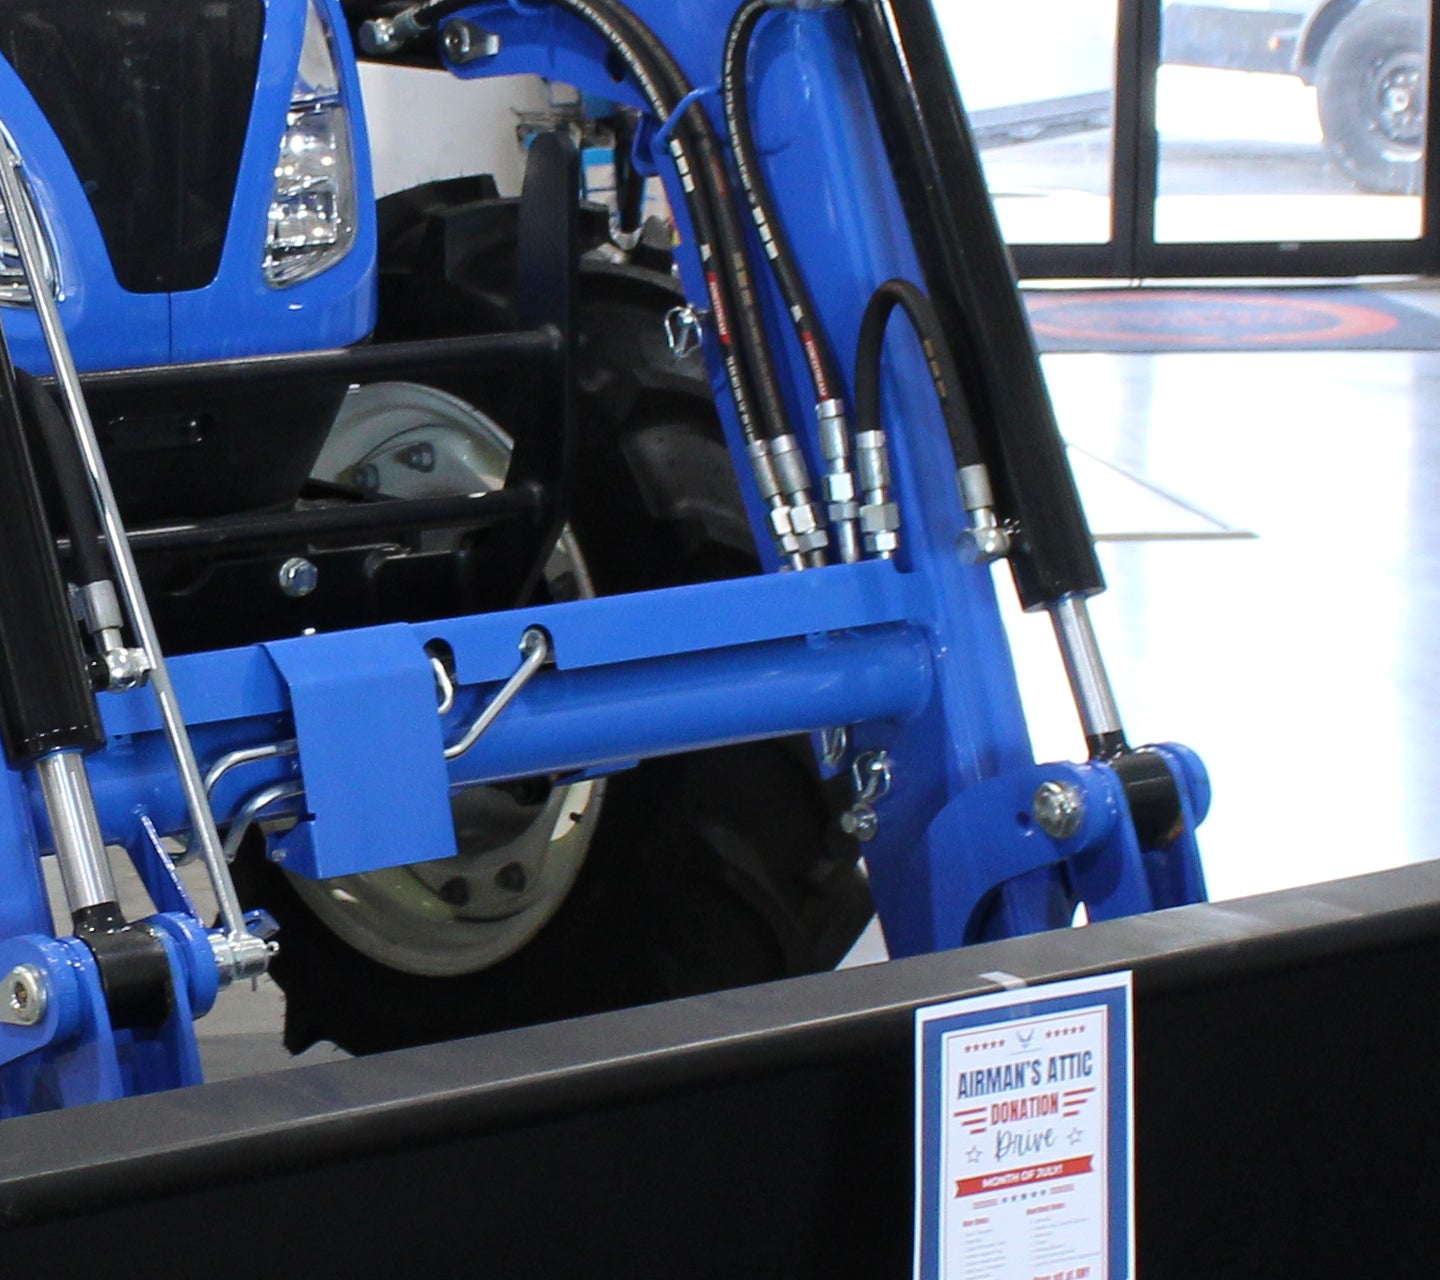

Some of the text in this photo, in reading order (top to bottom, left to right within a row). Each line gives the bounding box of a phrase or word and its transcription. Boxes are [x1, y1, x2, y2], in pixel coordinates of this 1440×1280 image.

[957, 1049, 1093, 1100] AIRMAN'S ATTIC
[990, 1092, 1060, 1126] DONATION
[995, 1127, 1058, 1162] Drive
[981, 1172, 1020, 1189] MONTH
[1020, 1169, 1034, 1183] OF
